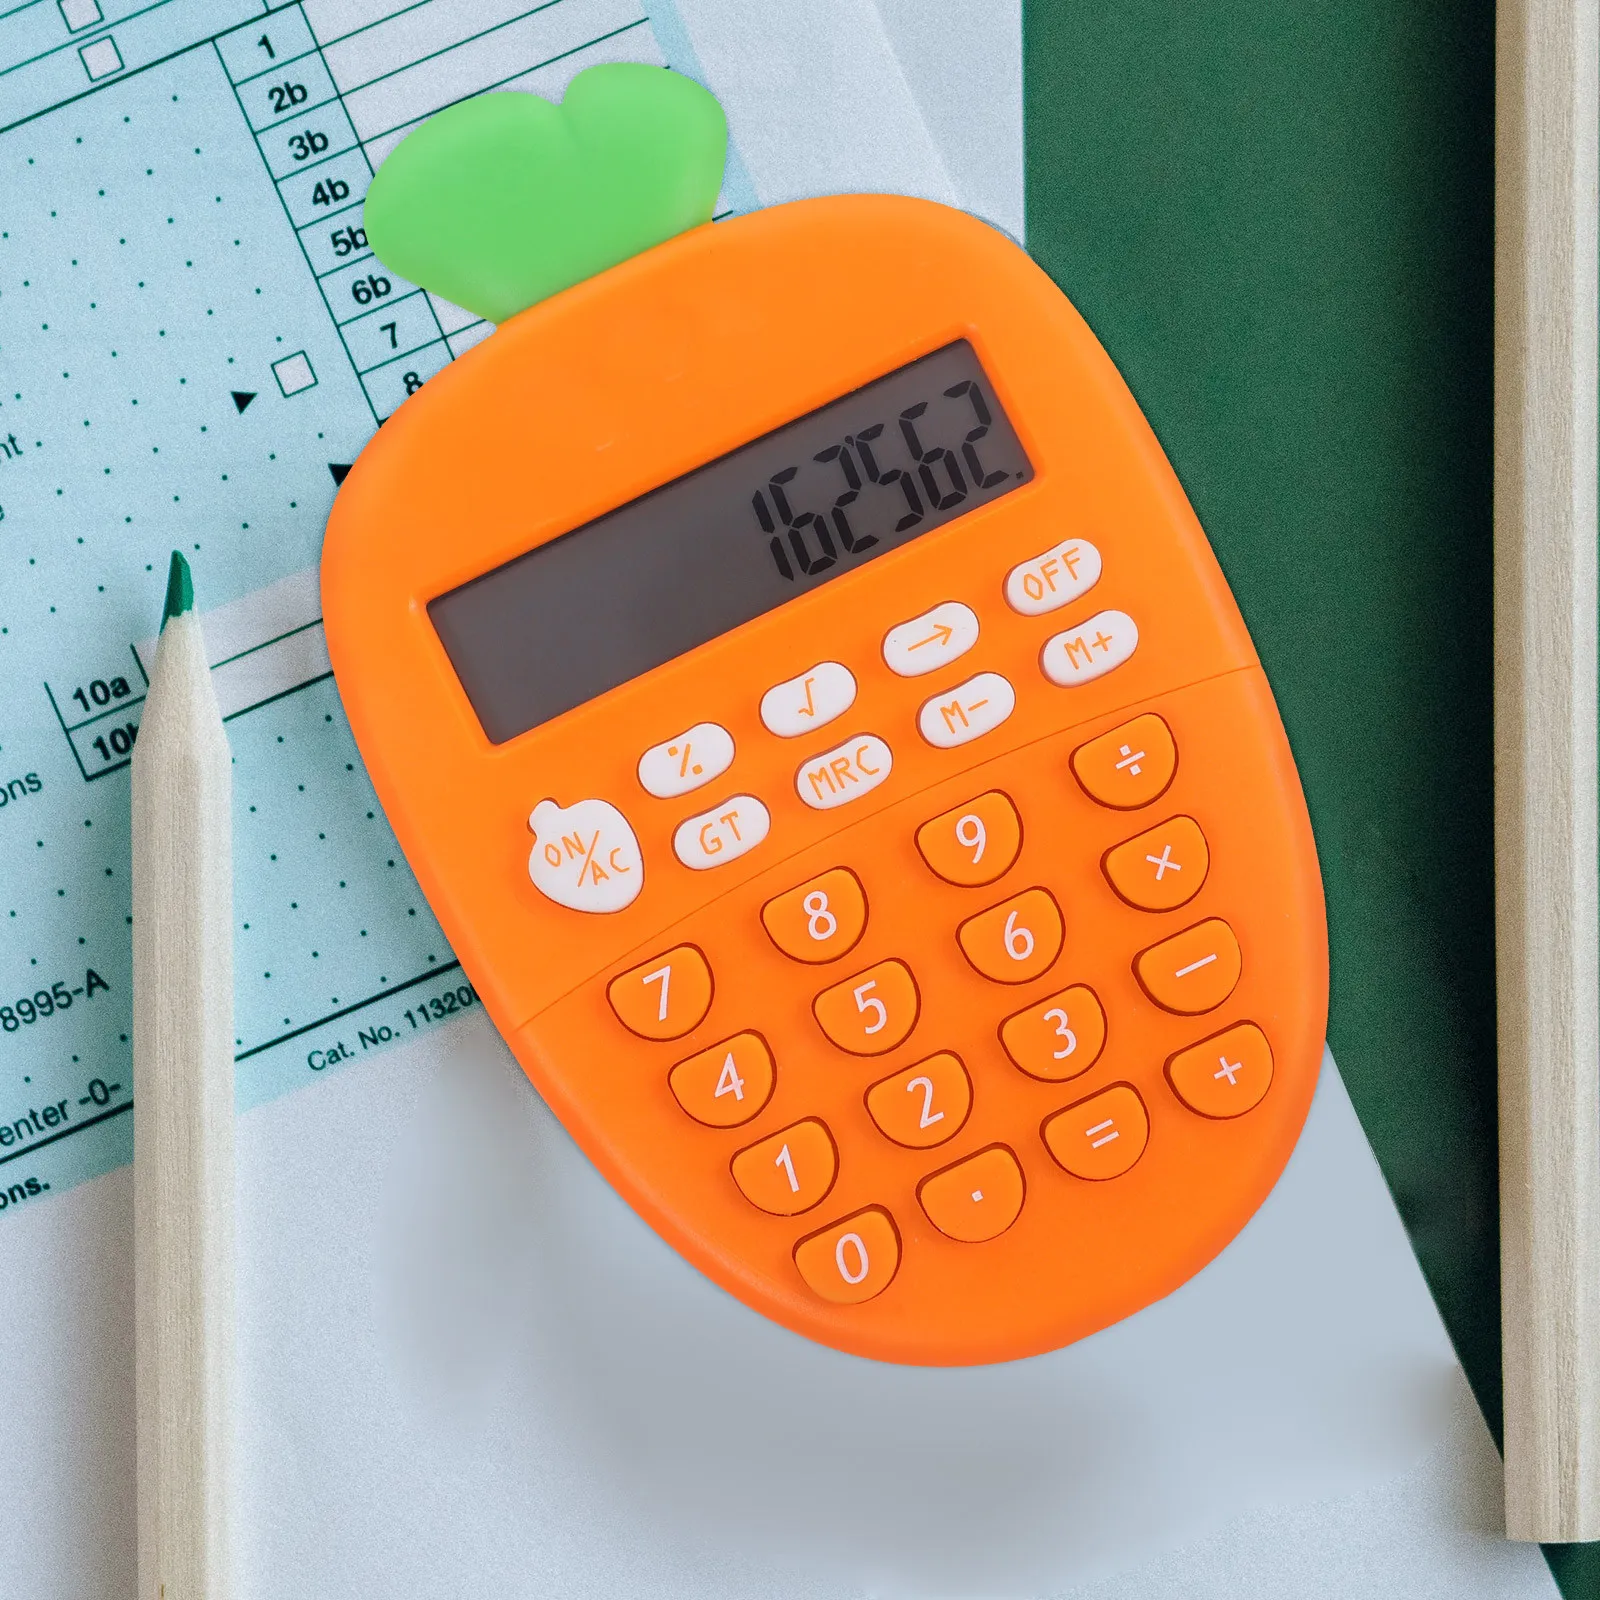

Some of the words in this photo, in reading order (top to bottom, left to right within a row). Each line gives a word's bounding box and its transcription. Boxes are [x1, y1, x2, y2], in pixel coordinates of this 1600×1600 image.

[258, 34, 276, 59] 1
[267, 81, 309, 114] 2b
[287, 130, 329, 161] 3b
[312, 177, 350, 207] 4b
[330, 225, 369, 257] 5b
[351, 274, 392, 305] 6b
[379, 321, 398, 349] 7
[1022, 546, 1081, 601] OFF
[1063, 630, 1114, 670] M+
[72, 675, 132, 712] 10a
[807, 744, 881, 801] MRC
[698, 810, 743, 855] GT
[954, 814, 987, 864] 9
[803, 890, 837, 941] 8
[1004, 910, 1035, 961] 6
[0, 967, 110, 1033] 8995-A
[641, 965, 671, 1021] 7
[853, 980, 887, 1034] 5
[307, 1041, 356, 1071] Cat.
[357, 1025, 401, 1050] No.
[1043, 1008, 1077, 1059] 3
[714, 1052, 745, 1101] 4
[0, 1098, 69, 1146] enter
[78, 1077, 122, 1106] -0-
[906, 1076, 945, 1129] 2
[774, 1143, 800, 1193] 1
[835, 1233, 869, 1284] 0
